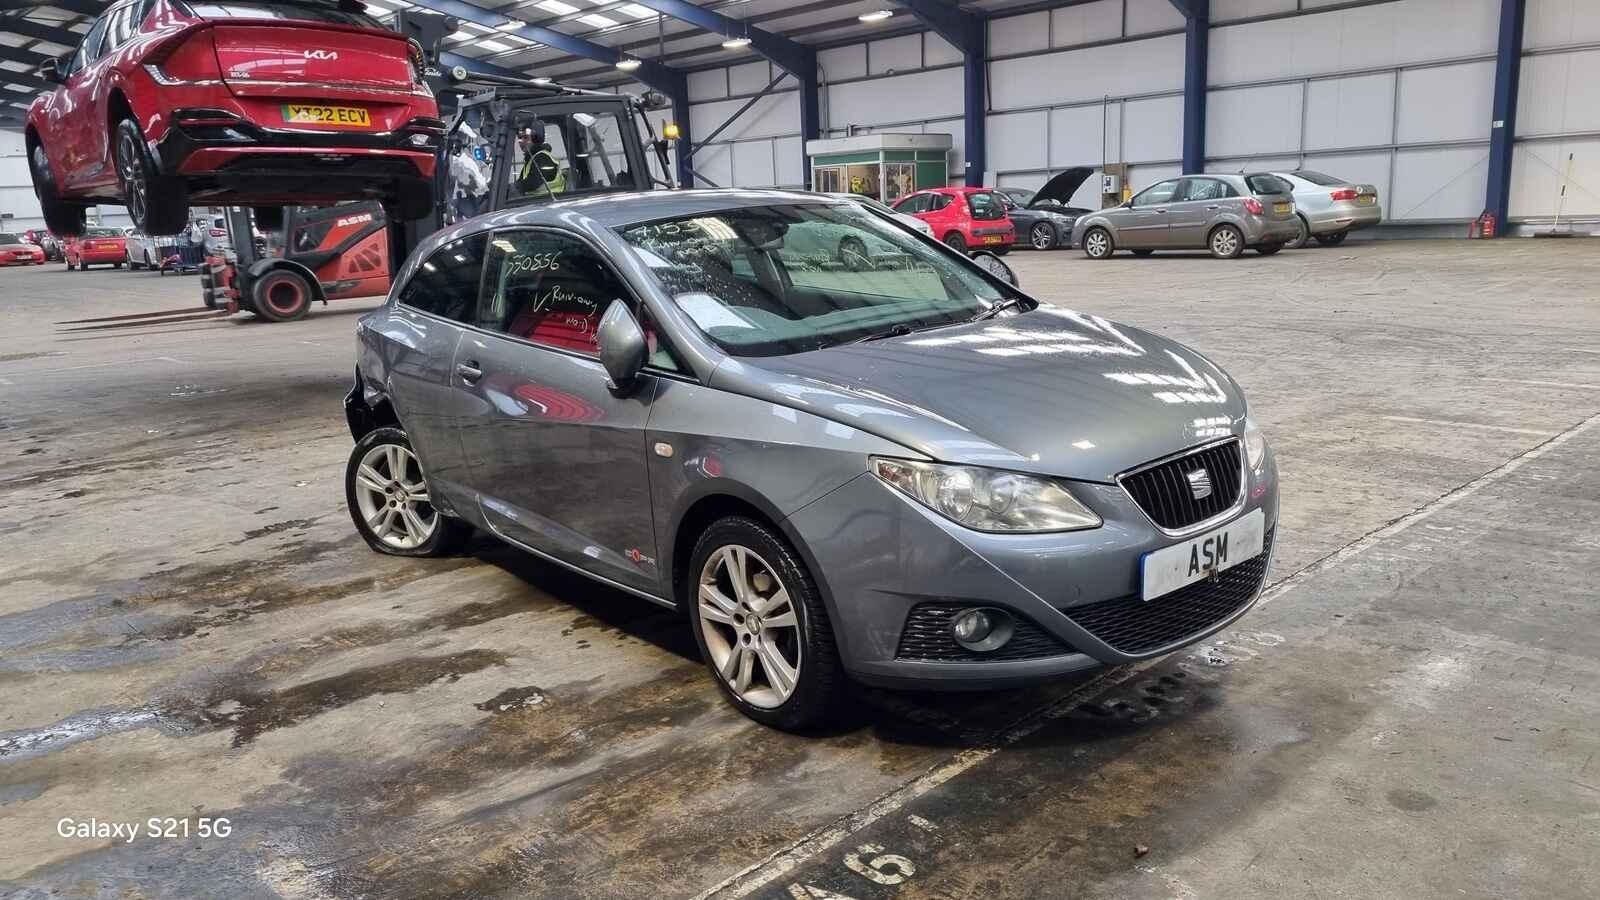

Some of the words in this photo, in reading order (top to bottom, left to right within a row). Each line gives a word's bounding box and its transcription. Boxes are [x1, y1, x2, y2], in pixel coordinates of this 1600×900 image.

[337, 108, 367, 123] ECV
[337, 213, 372, 227] ASM
[1188, 531, 1228, 577] ASM
